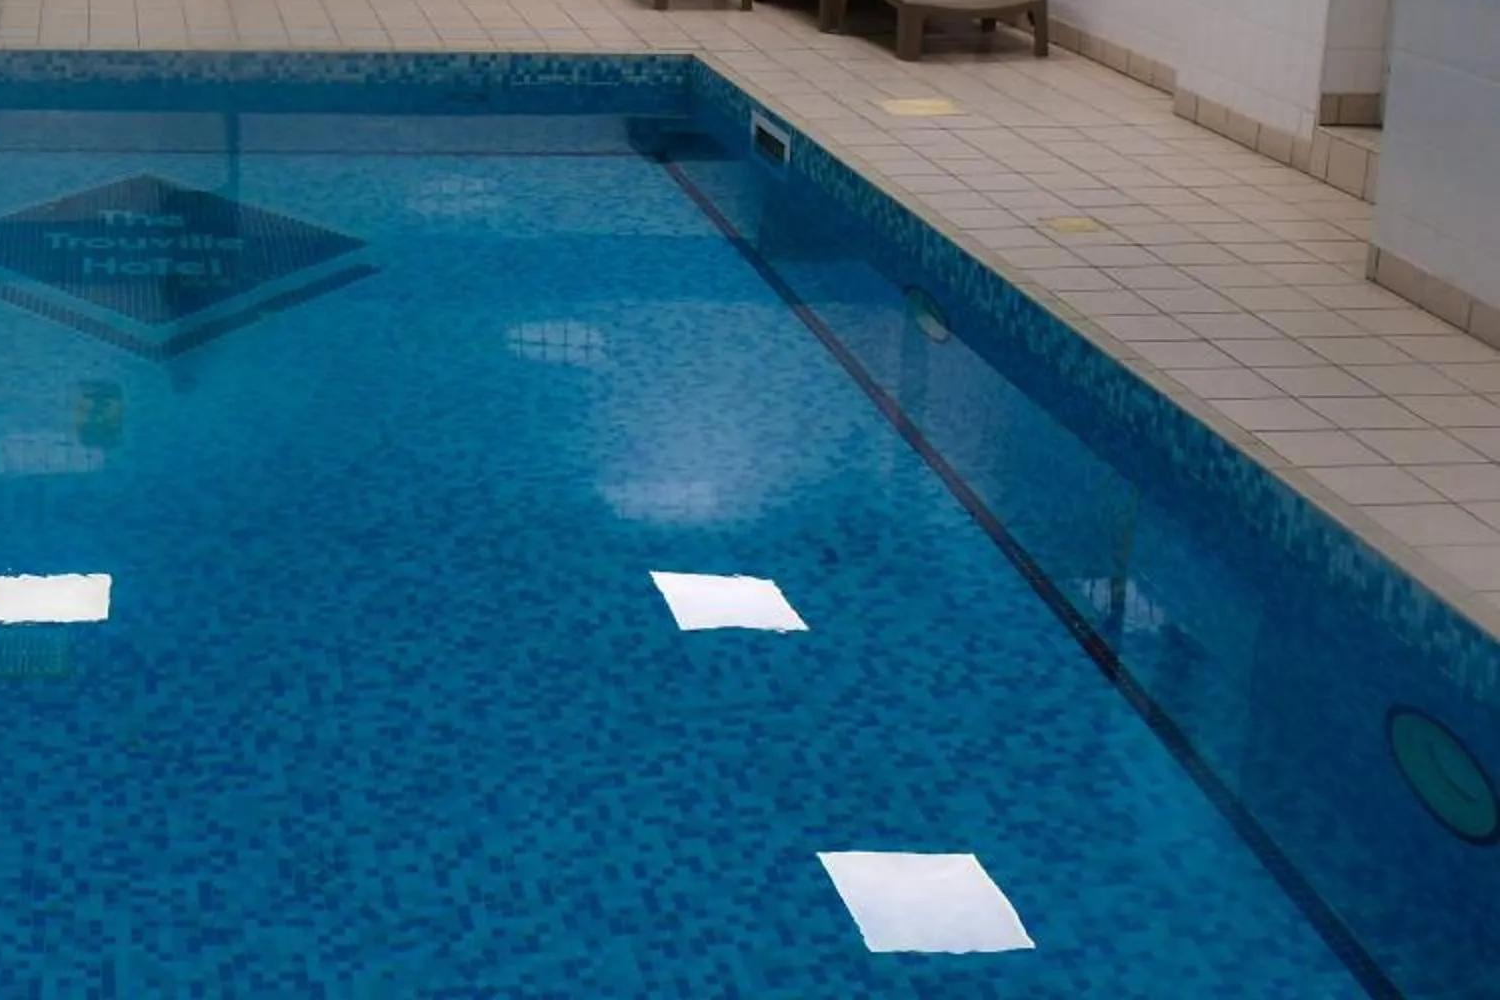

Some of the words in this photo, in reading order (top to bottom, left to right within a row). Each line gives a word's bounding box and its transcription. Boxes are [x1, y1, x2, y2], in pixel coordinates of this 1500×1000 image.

[99, 209, 185, 227] The
[44, 232, 244, 250] Trouville
[83, 257, 221, 275] Hotel
